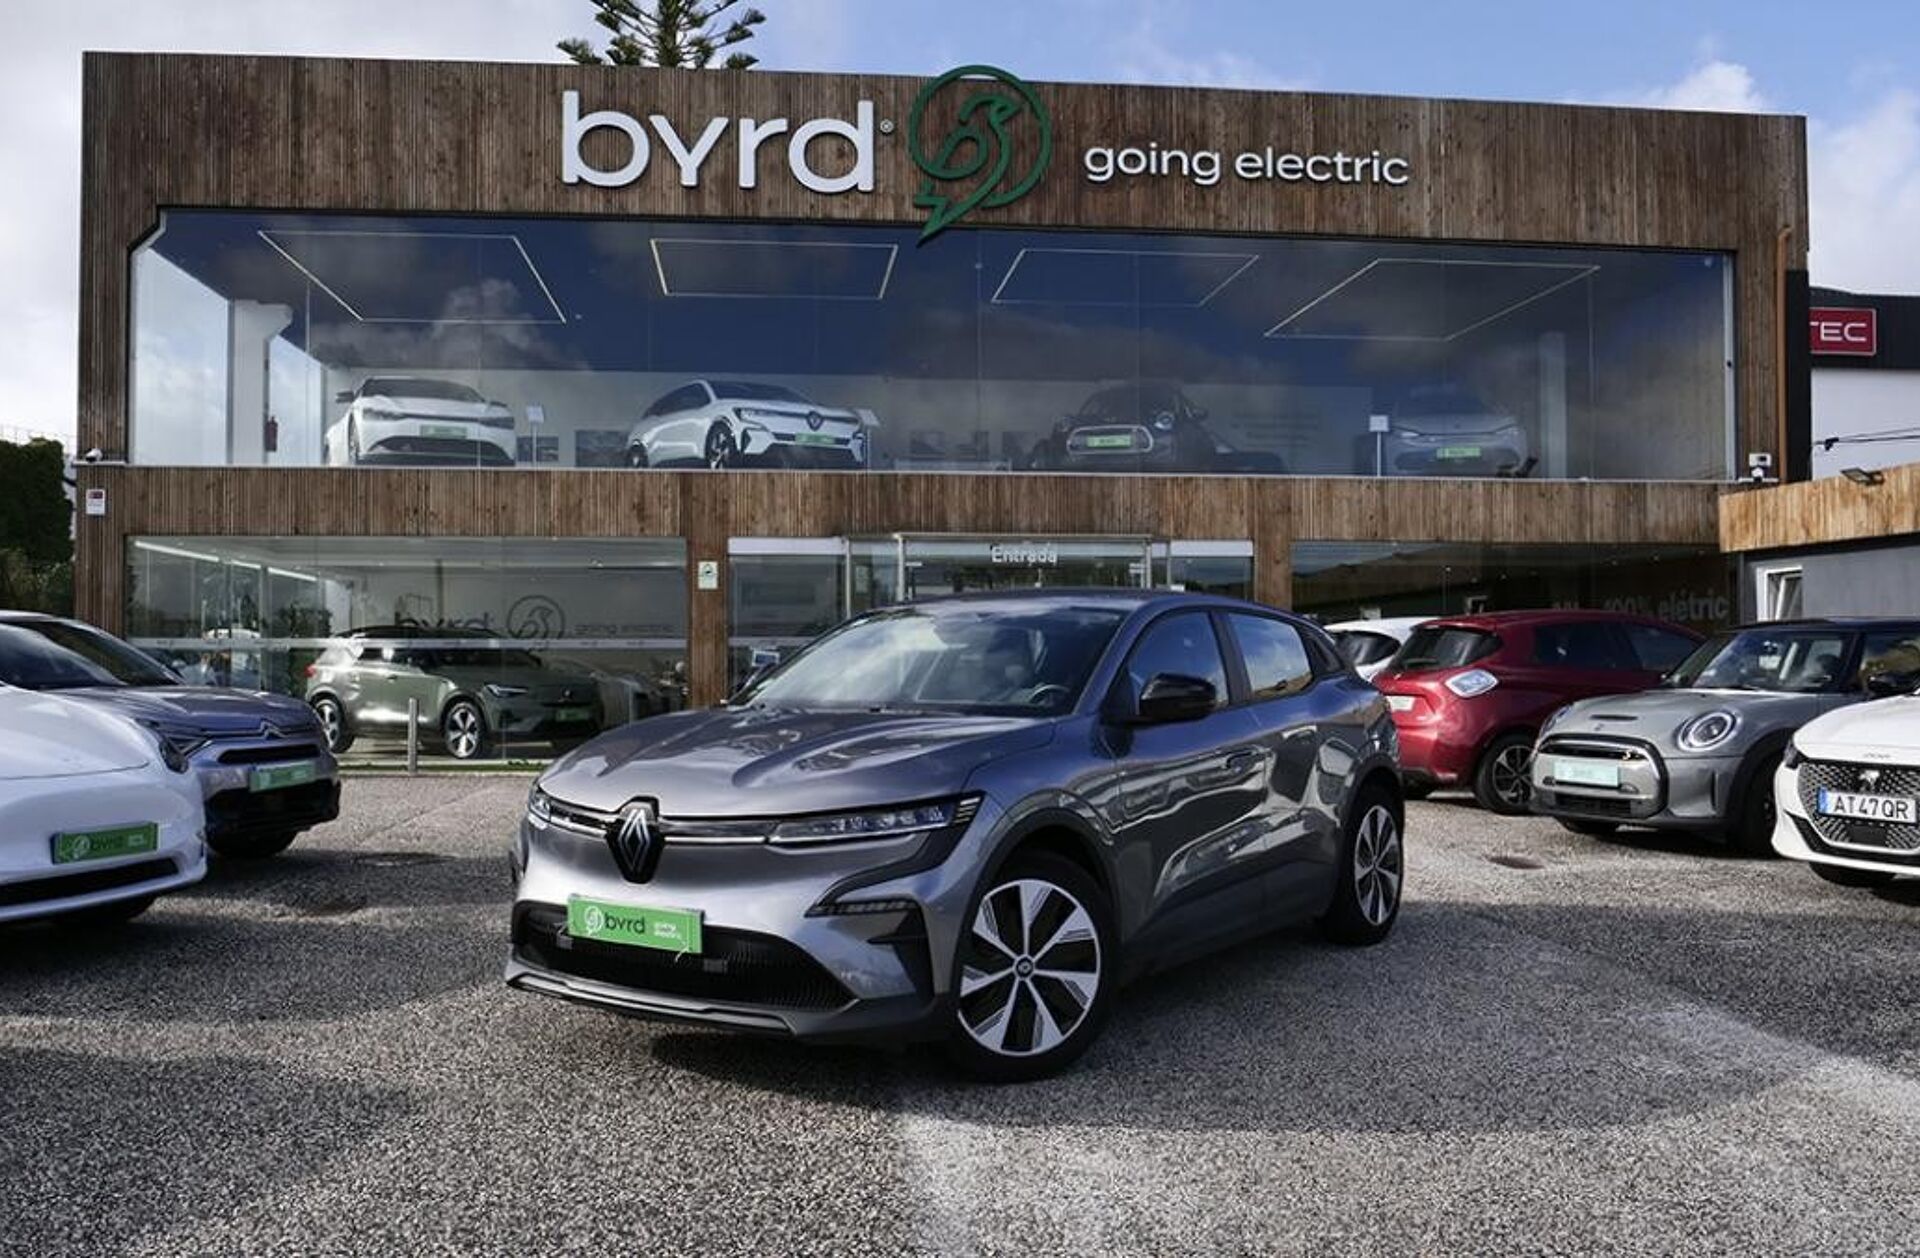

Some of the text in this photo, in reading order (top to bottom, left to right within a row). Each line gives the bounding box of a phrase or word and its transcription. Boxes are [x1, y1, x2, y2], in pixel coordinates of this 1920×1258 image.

[562, 90, 874, 193] byrd
[1085, 142, 1408, 185] going electric
[604, 911, 645, 934] byrd
